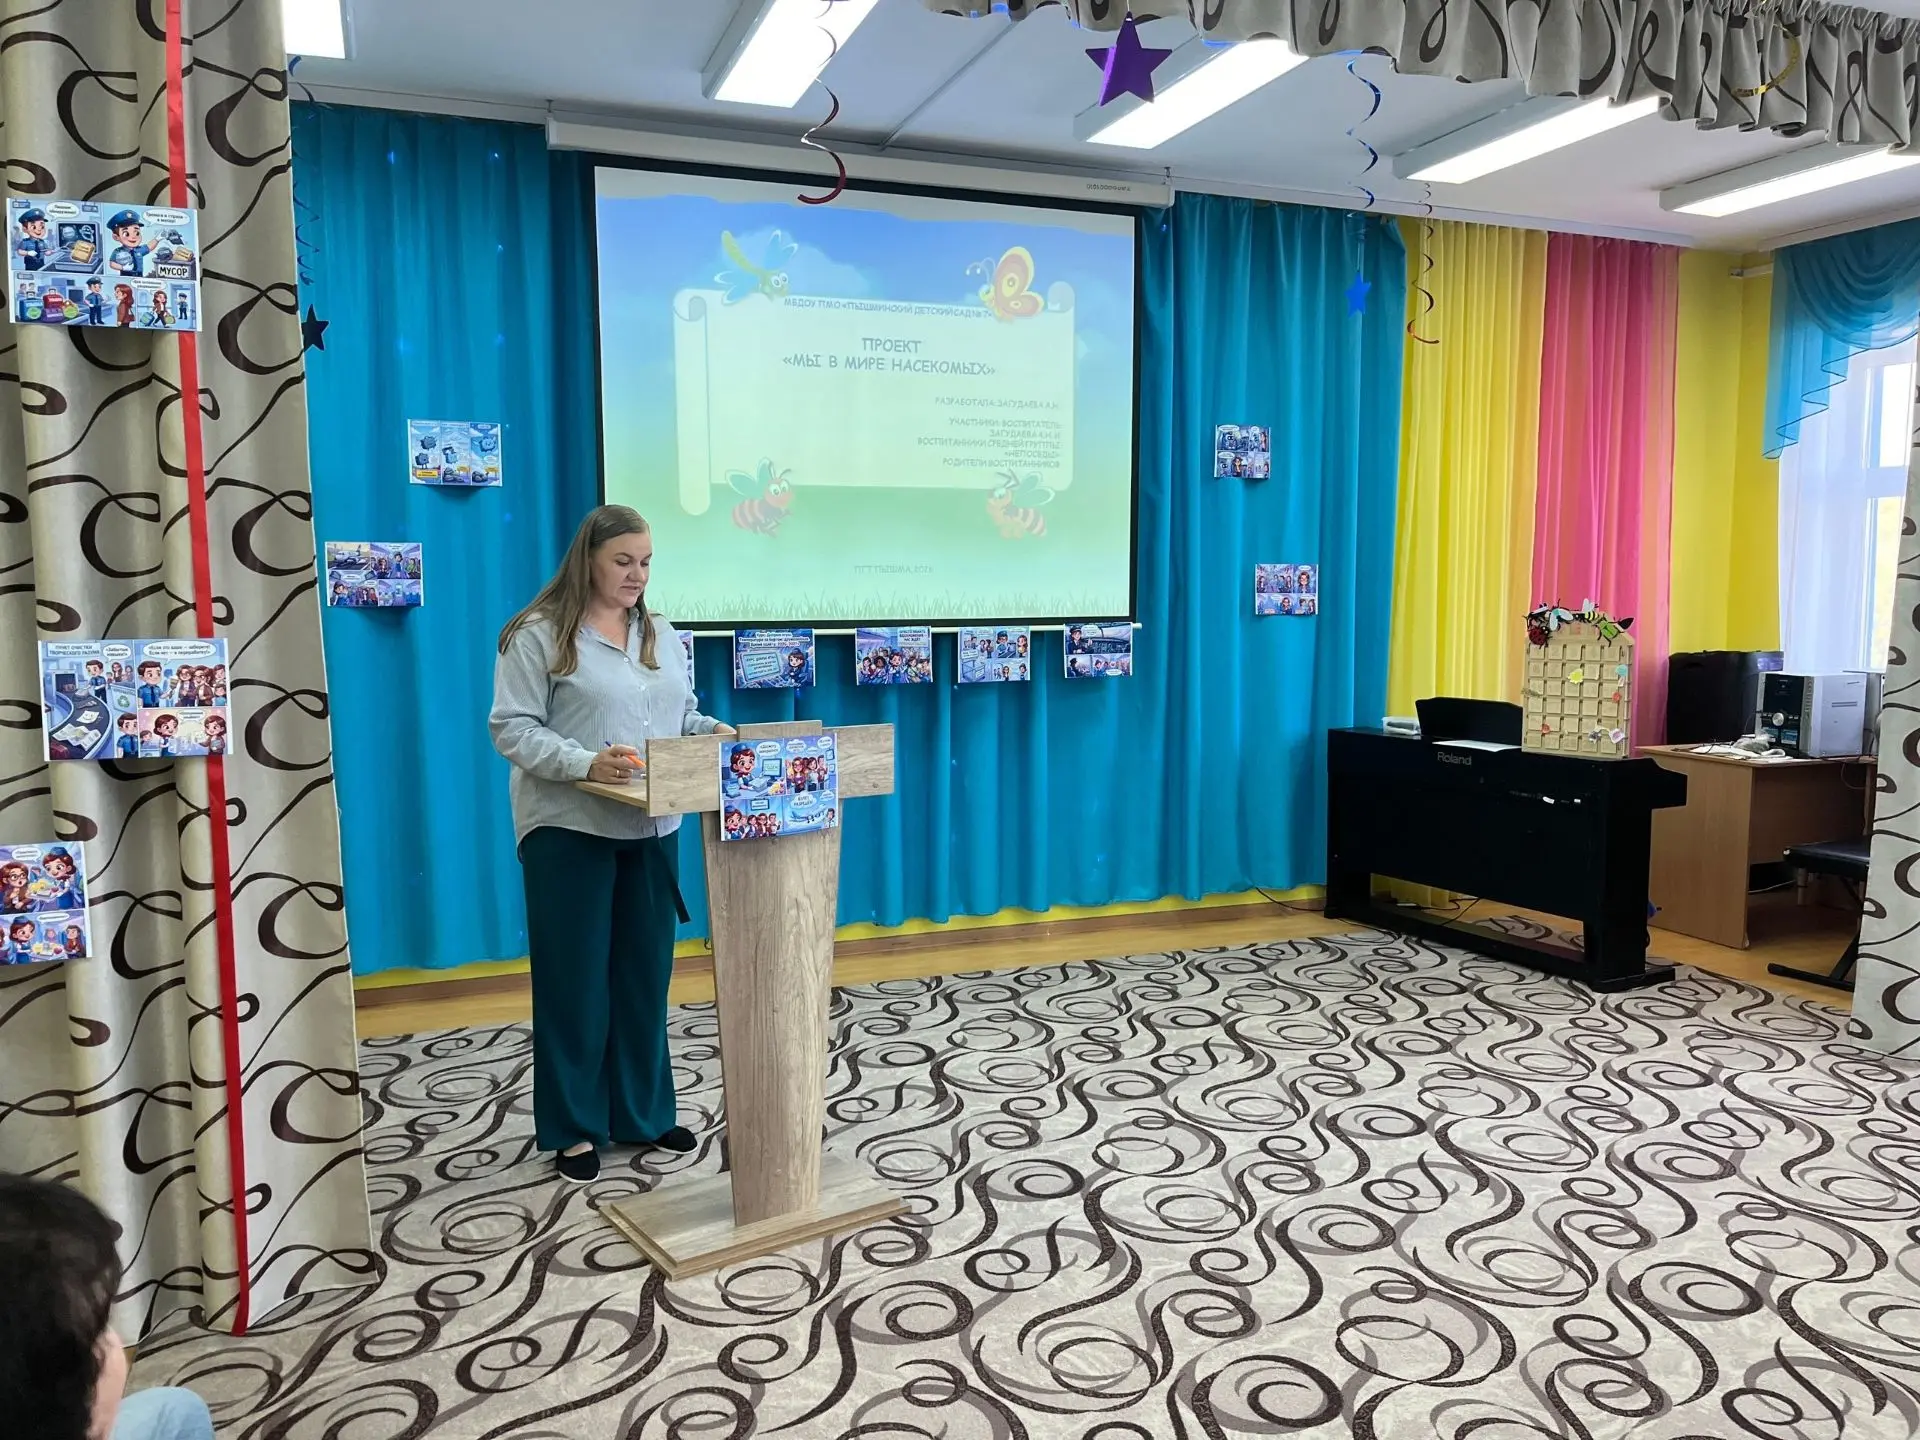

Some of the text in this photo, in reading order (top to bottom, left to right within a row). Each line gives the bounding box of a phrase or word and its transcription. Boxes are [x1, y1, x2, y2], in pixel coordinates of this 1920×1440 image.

[160, 266, 188, 277] МУСОР
[861, 337, 922, 354] ПРОЕКТ
[782, 353, 996, 376] «МЫ В МИРЕ НАСЕКОМЫХ»
[1437, 751, 1472, 766] Roland
